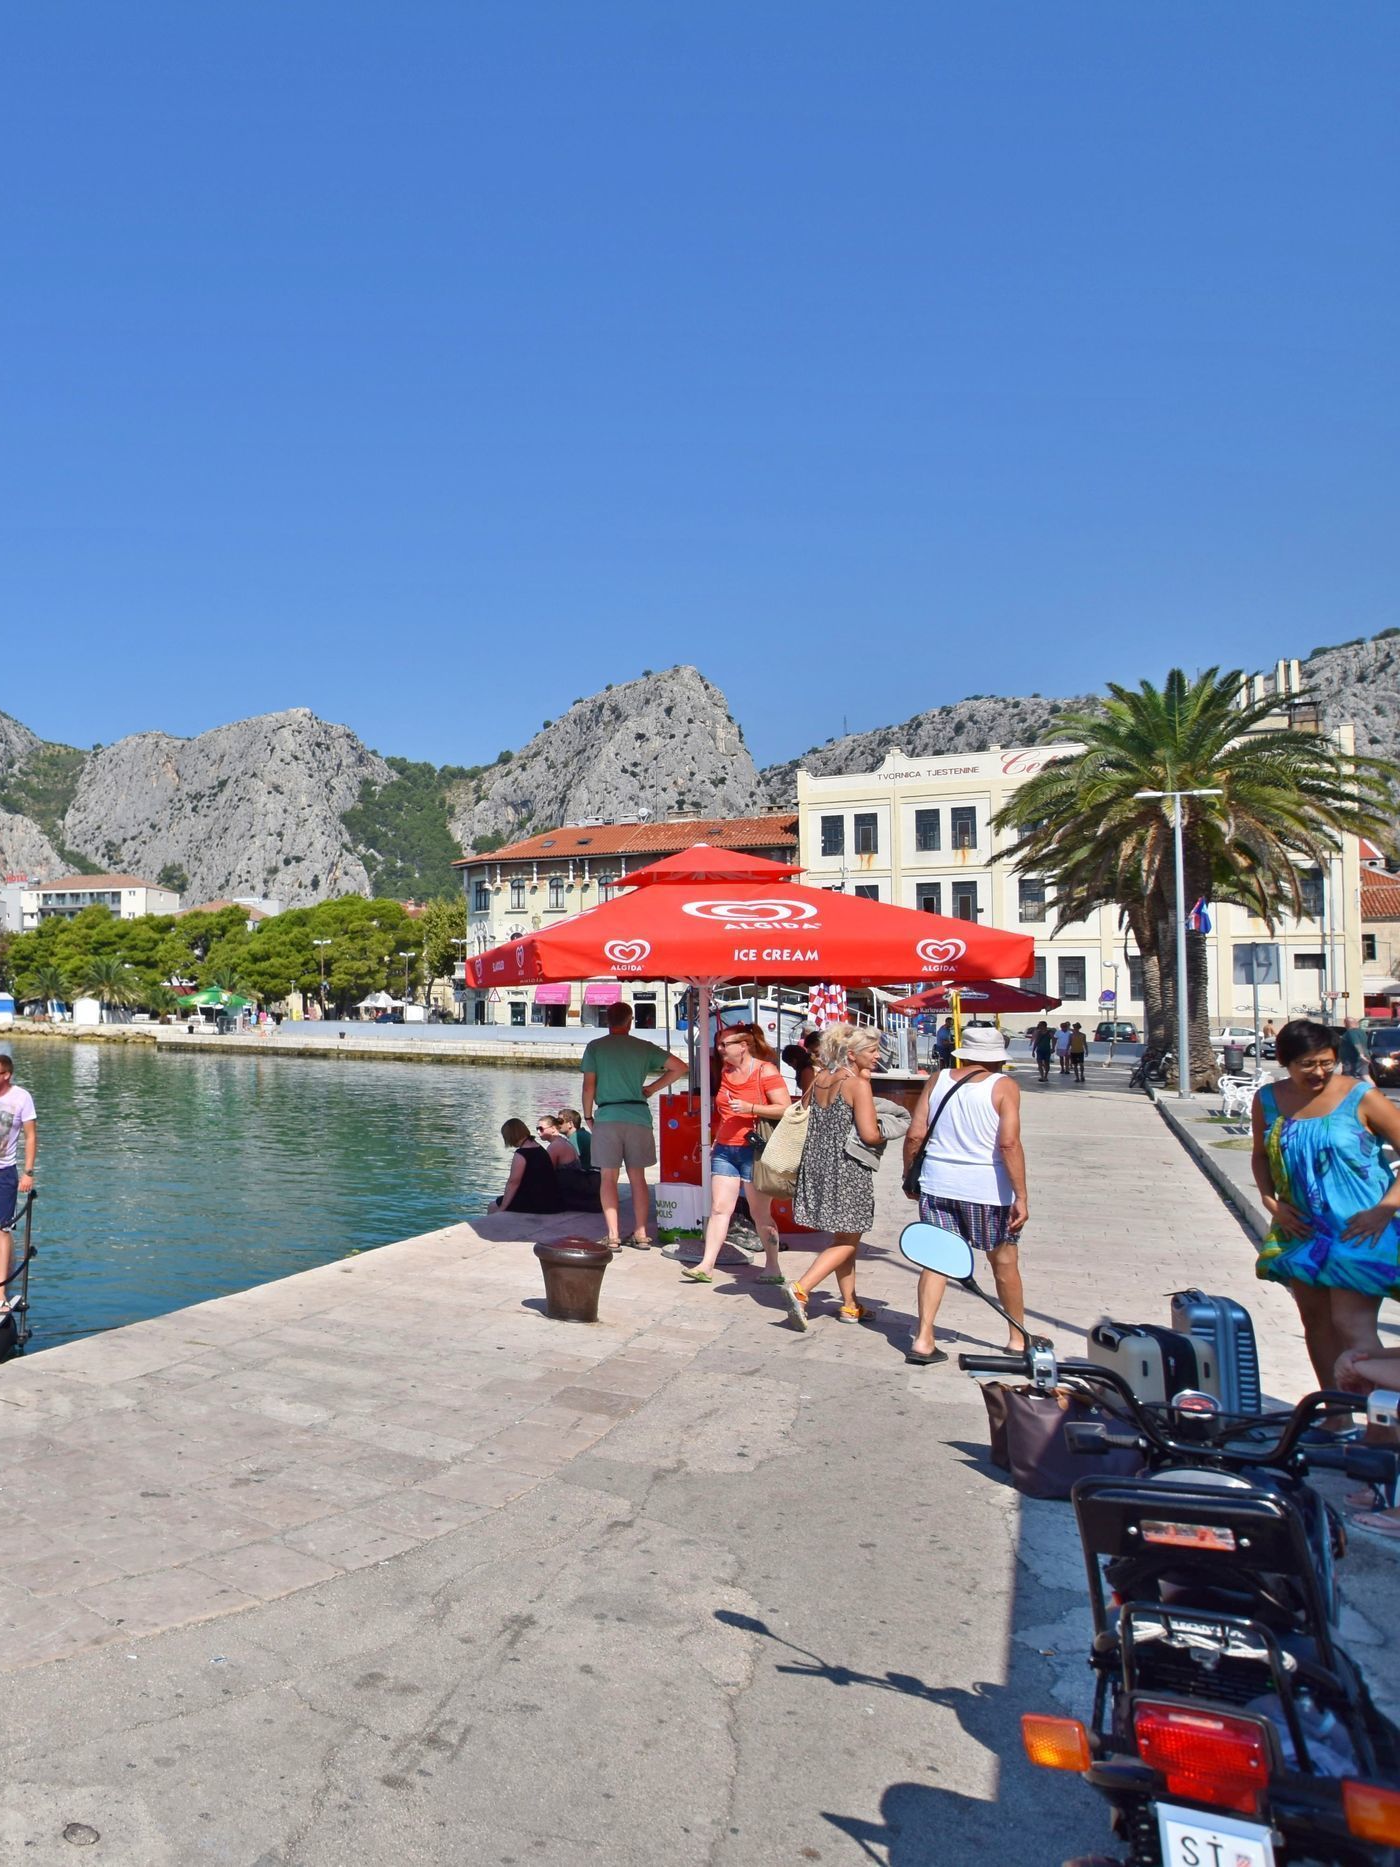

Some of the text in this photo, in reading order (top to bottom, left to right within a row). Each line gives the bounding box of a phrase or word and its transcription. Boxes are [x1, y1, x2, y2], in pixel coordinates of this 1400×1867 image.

[877, 766, 980, 781] TVORNICA TJESTENINE
[733, 948, 820, 962] ICE CREAM
[610, 964, 643, 972] ALGIDA
[921, 964, 957, 973] ALGIDA
